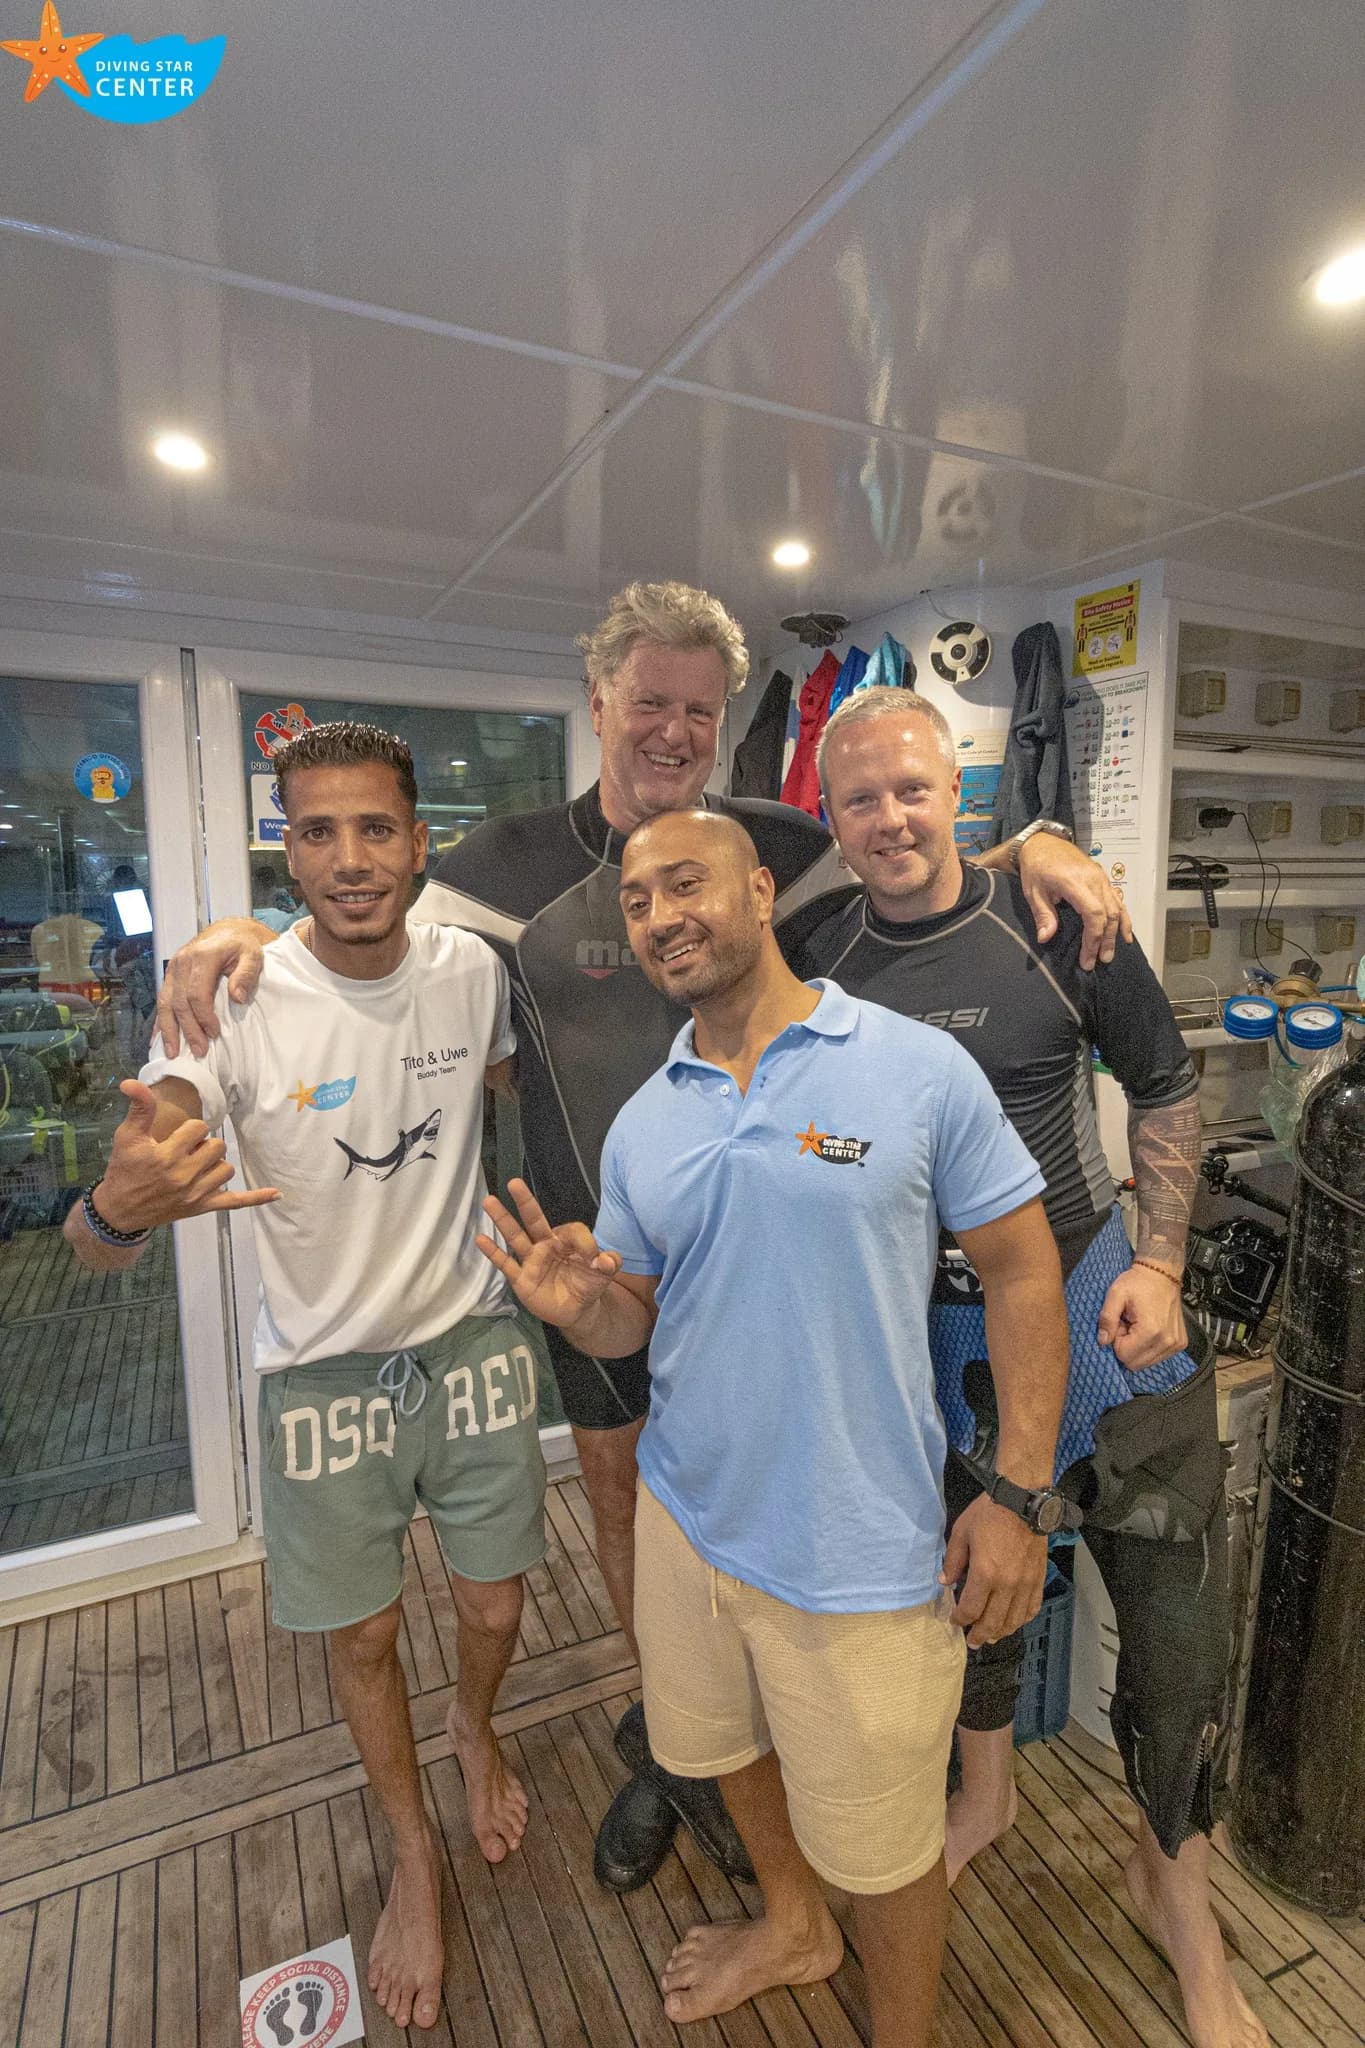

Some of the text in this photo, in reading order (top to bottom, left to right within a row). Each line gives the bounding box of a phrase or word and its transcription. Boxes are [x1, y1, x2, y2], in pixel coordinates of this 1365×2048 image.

[400, 1047, 468, 1071] Tito & Uwe
[417, 1066, 456, 1080] Buddy Team
[822, 1147, 861, 1159] CENTER
[823, 1138, 862, 1150] DIVING STAR
[443, 1344, 536, 1441] RED
[252, 1979, 277, 2007] KEEP
[280, 1963, 320, 1980] SOCIAL
[322, 1966, 346, 2013] DISTANCE
